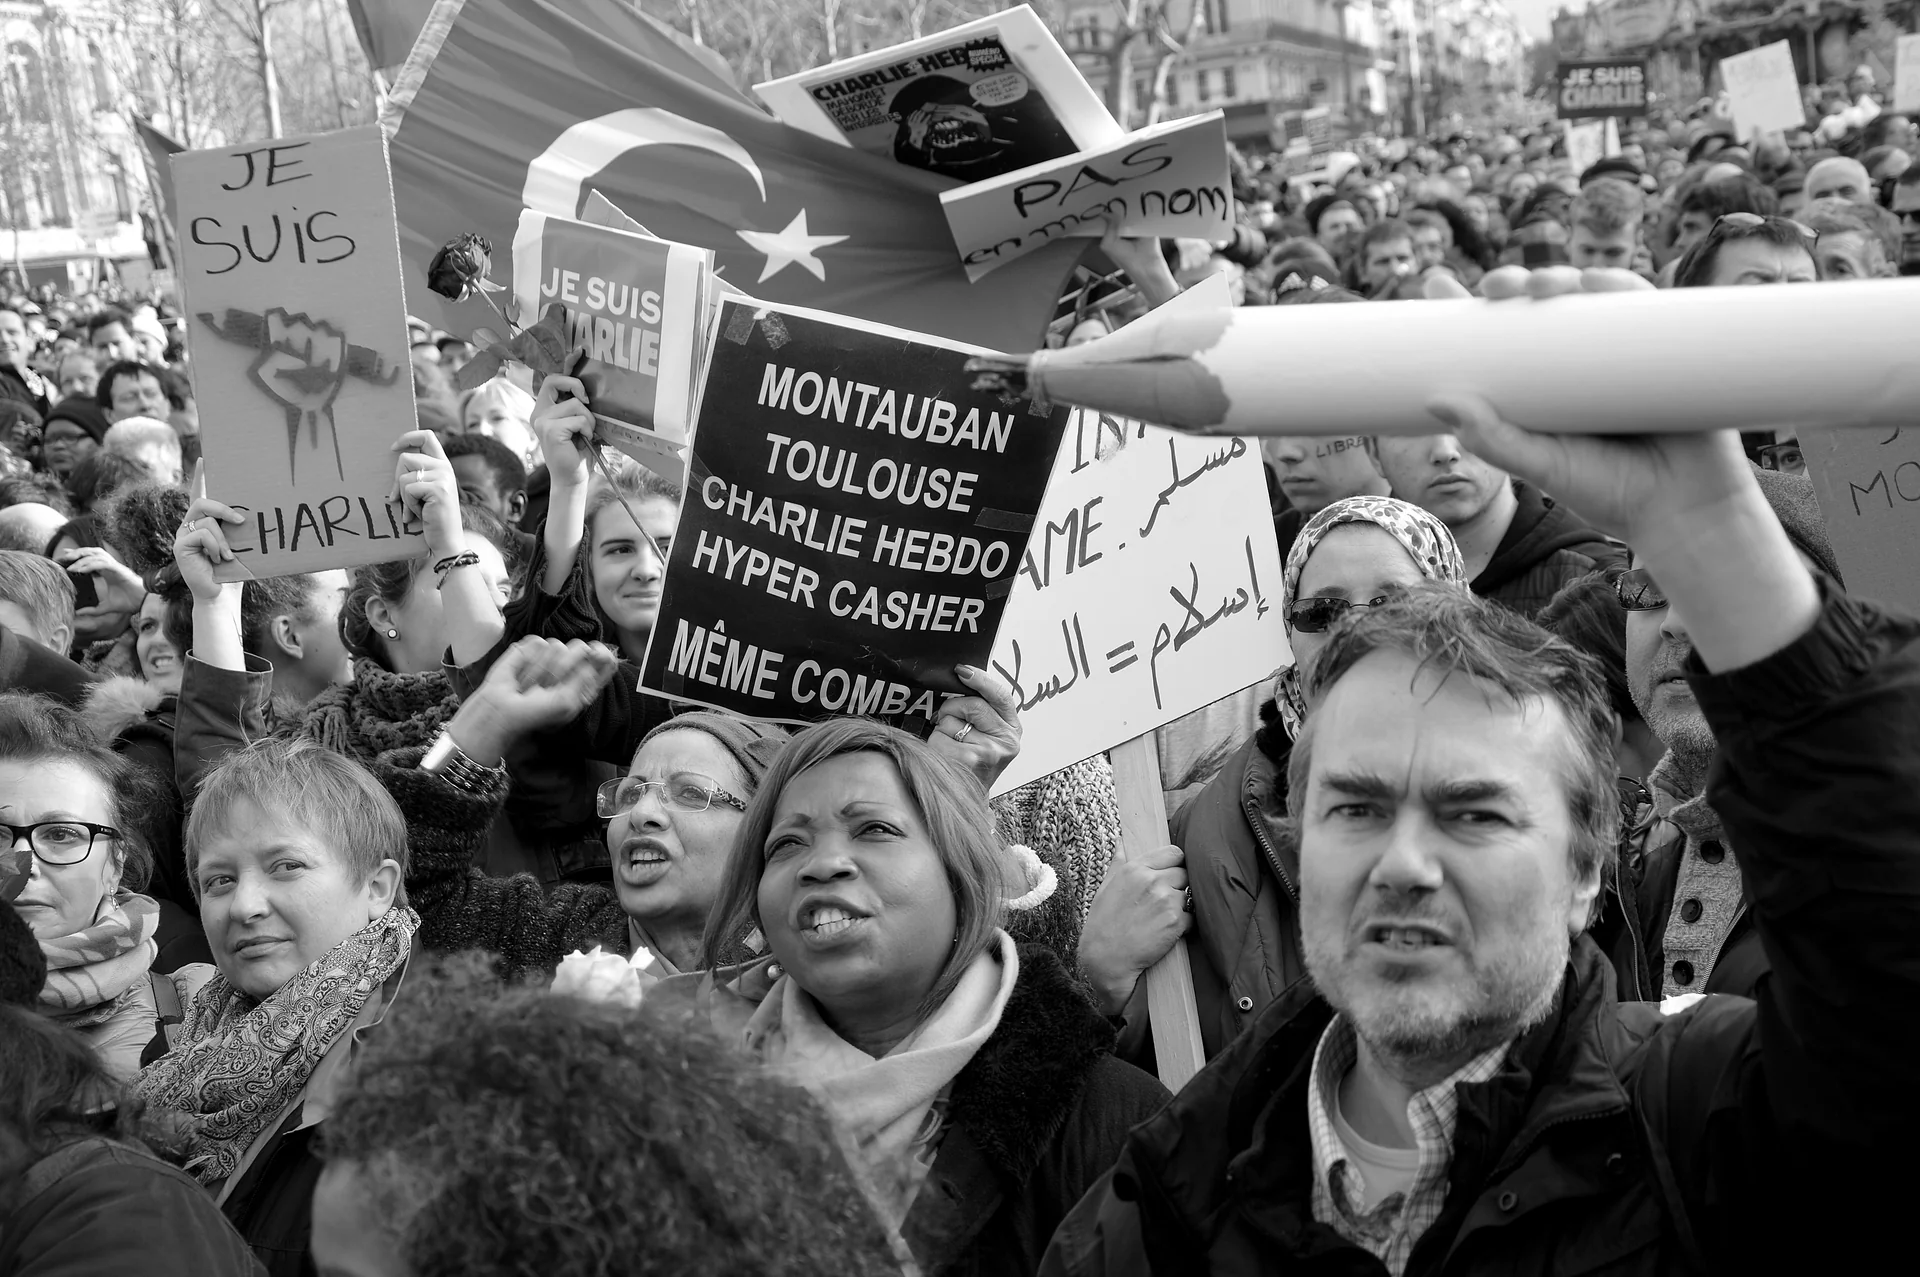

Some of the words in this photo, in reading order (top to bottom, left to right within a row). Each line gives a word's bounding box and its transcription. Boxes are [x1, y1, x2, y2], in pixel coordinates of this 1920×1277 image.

[813, 62, 917, 100] CHARLIE
[1562, 68, 1592, 87] JE
[1593, 66, 1643, 84] SUIS
[221, 141, 313, 191] JE
[1014, 143, 1172, 218] PAS
[963, 238, 1022, 265] en
[1028, 197, 1127, 237] mon
[1140, 186, 1227, 221] nom
[541, 267, 580, 304] JE
[585, 277, 661, 324] SUIS
[539, 303, 660, 377] ARLIE
[757, 363, 1015, 453] MONTAUBAN
[766, 432, 980, 513] TOULOUSE
[702, 475, 867, 558] CHARLIE
[873, 525, 1010, 579] HEBDO
[691, 530, 820, 608] HYPER
[828, 581, 985, 634] CASHER
[667, 617, 784, 700] MÊME
